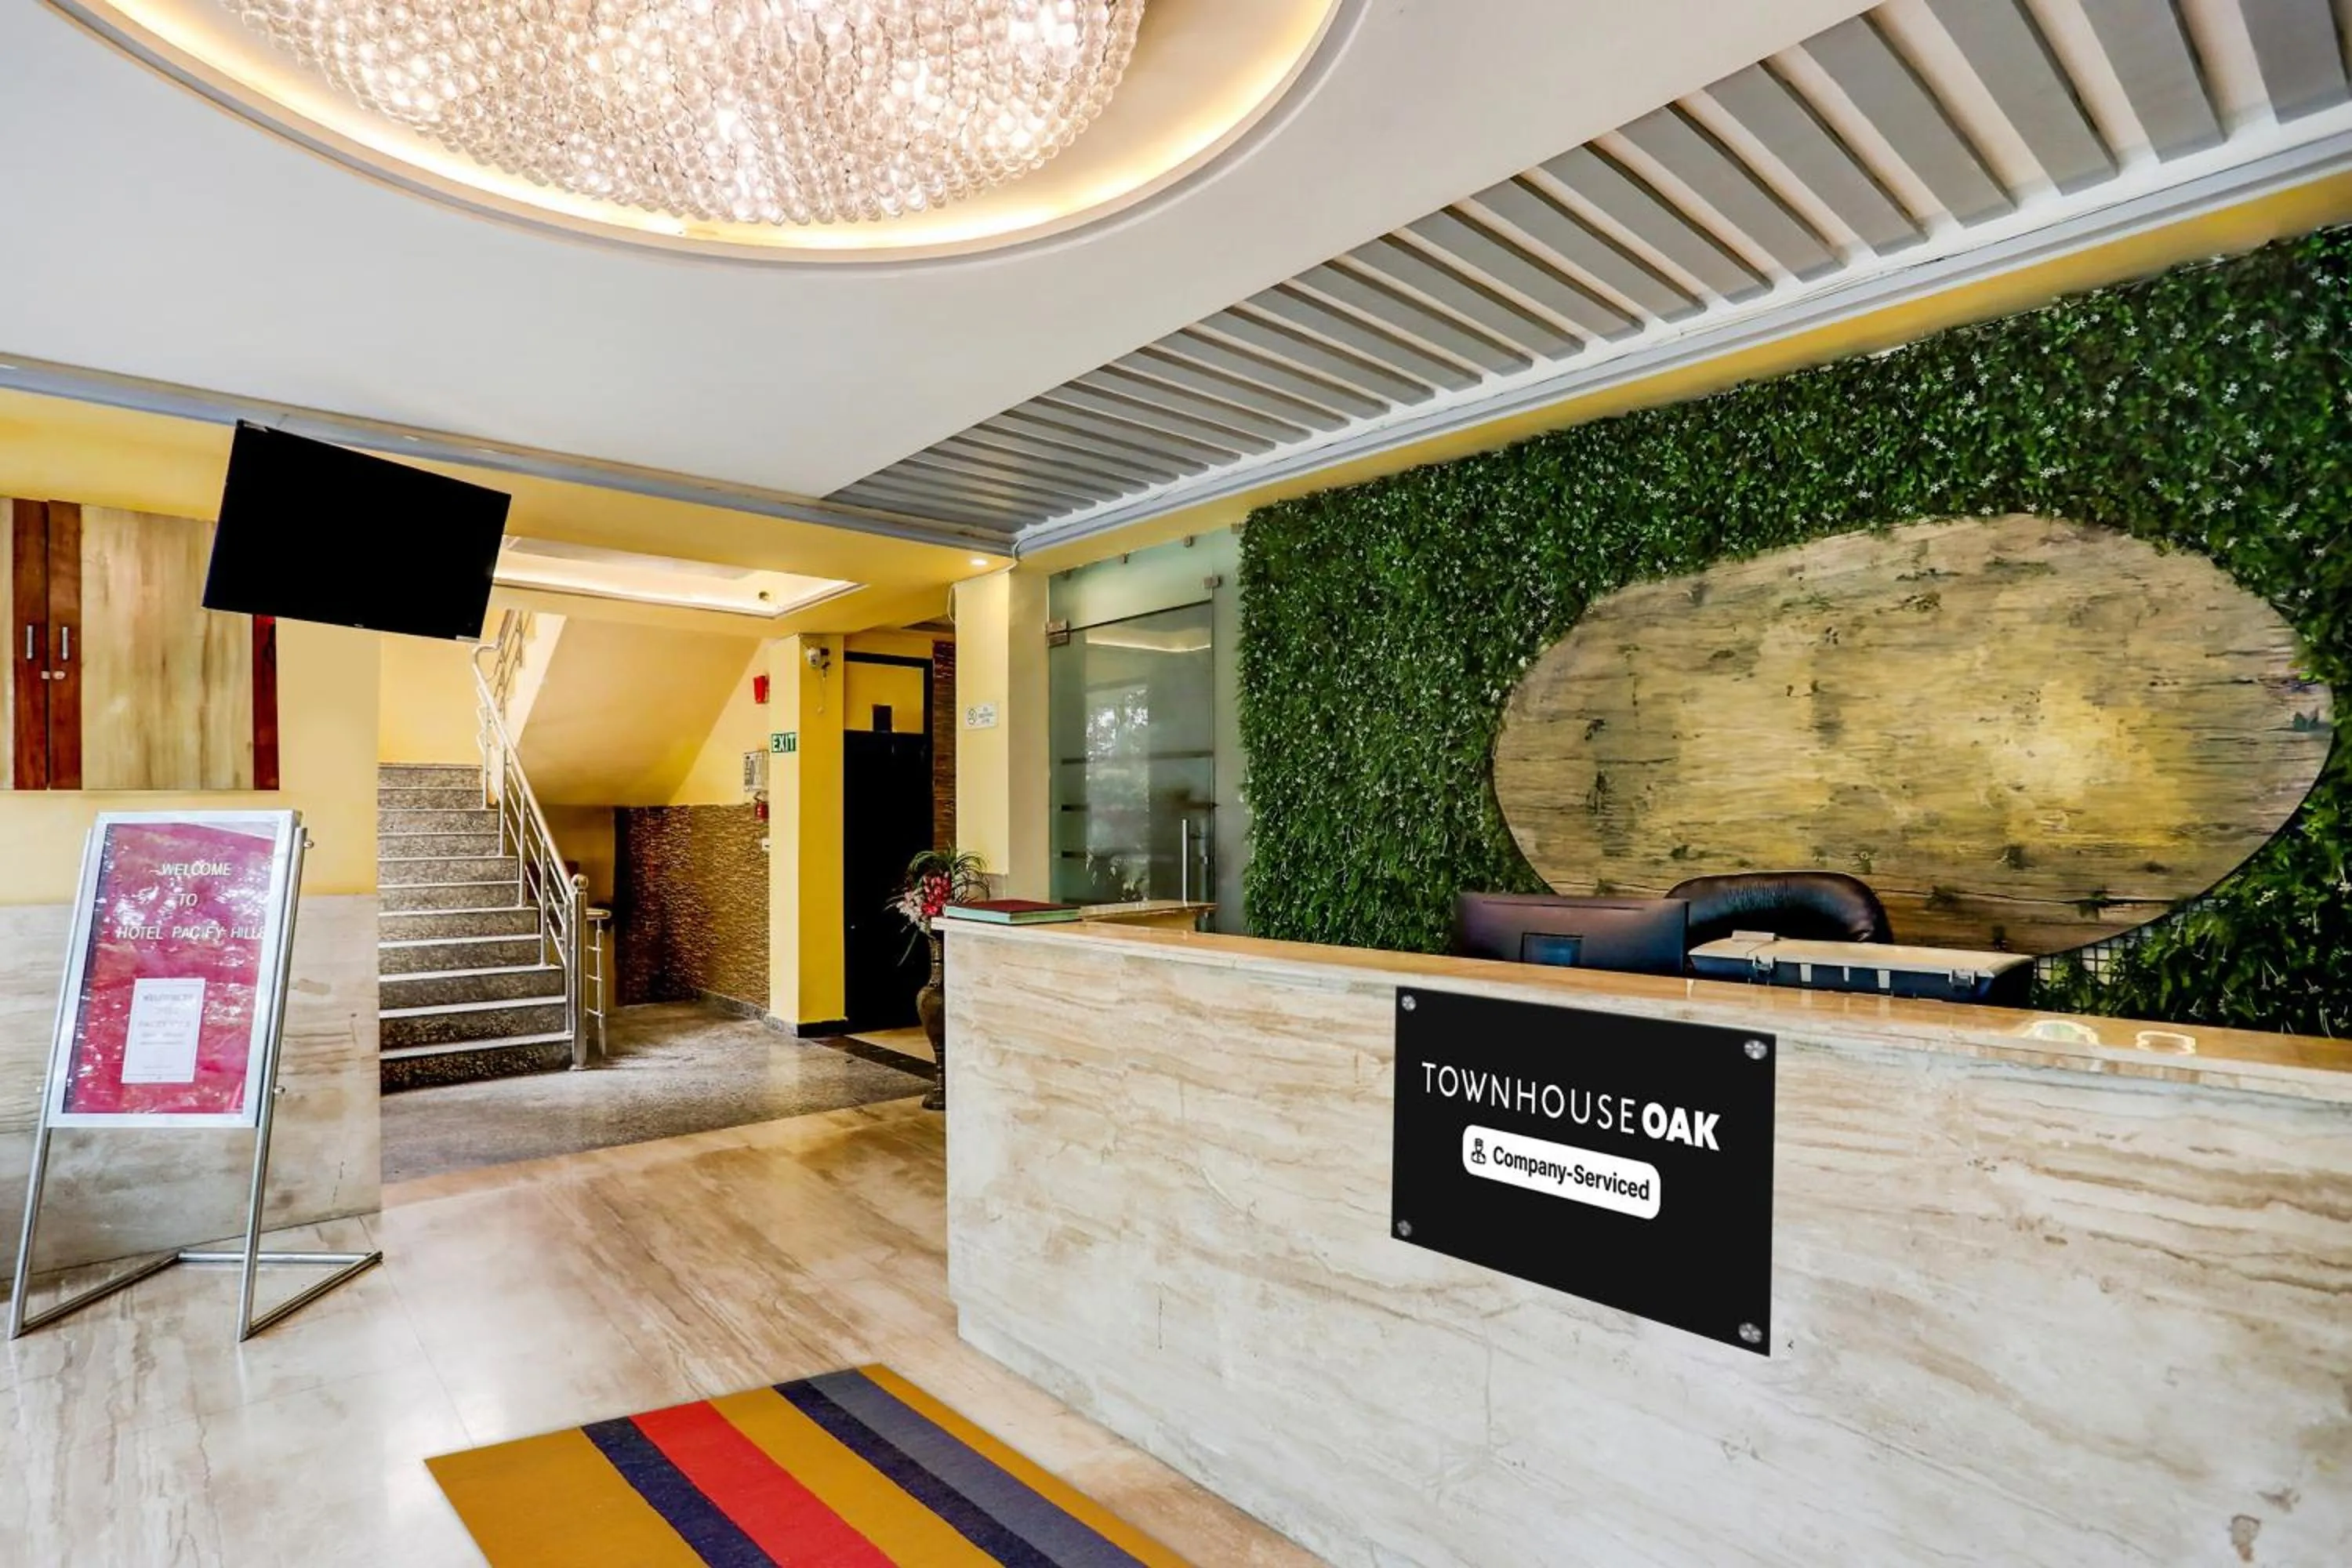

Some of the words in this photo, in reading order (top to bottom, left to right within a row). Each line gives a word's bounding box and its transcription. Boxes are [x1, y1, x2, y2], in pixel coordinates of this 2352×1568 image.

[772, 734, 796, 751] EXIT
[162, 863, 232, 876] WELCOME
[180, 894, 198, 906] TO
[117, 926, 164, 939] HOTEL
[172, 926, 223, 939] PACIFY
[1493, 1146, 1650, 1201] Company-Serviced
